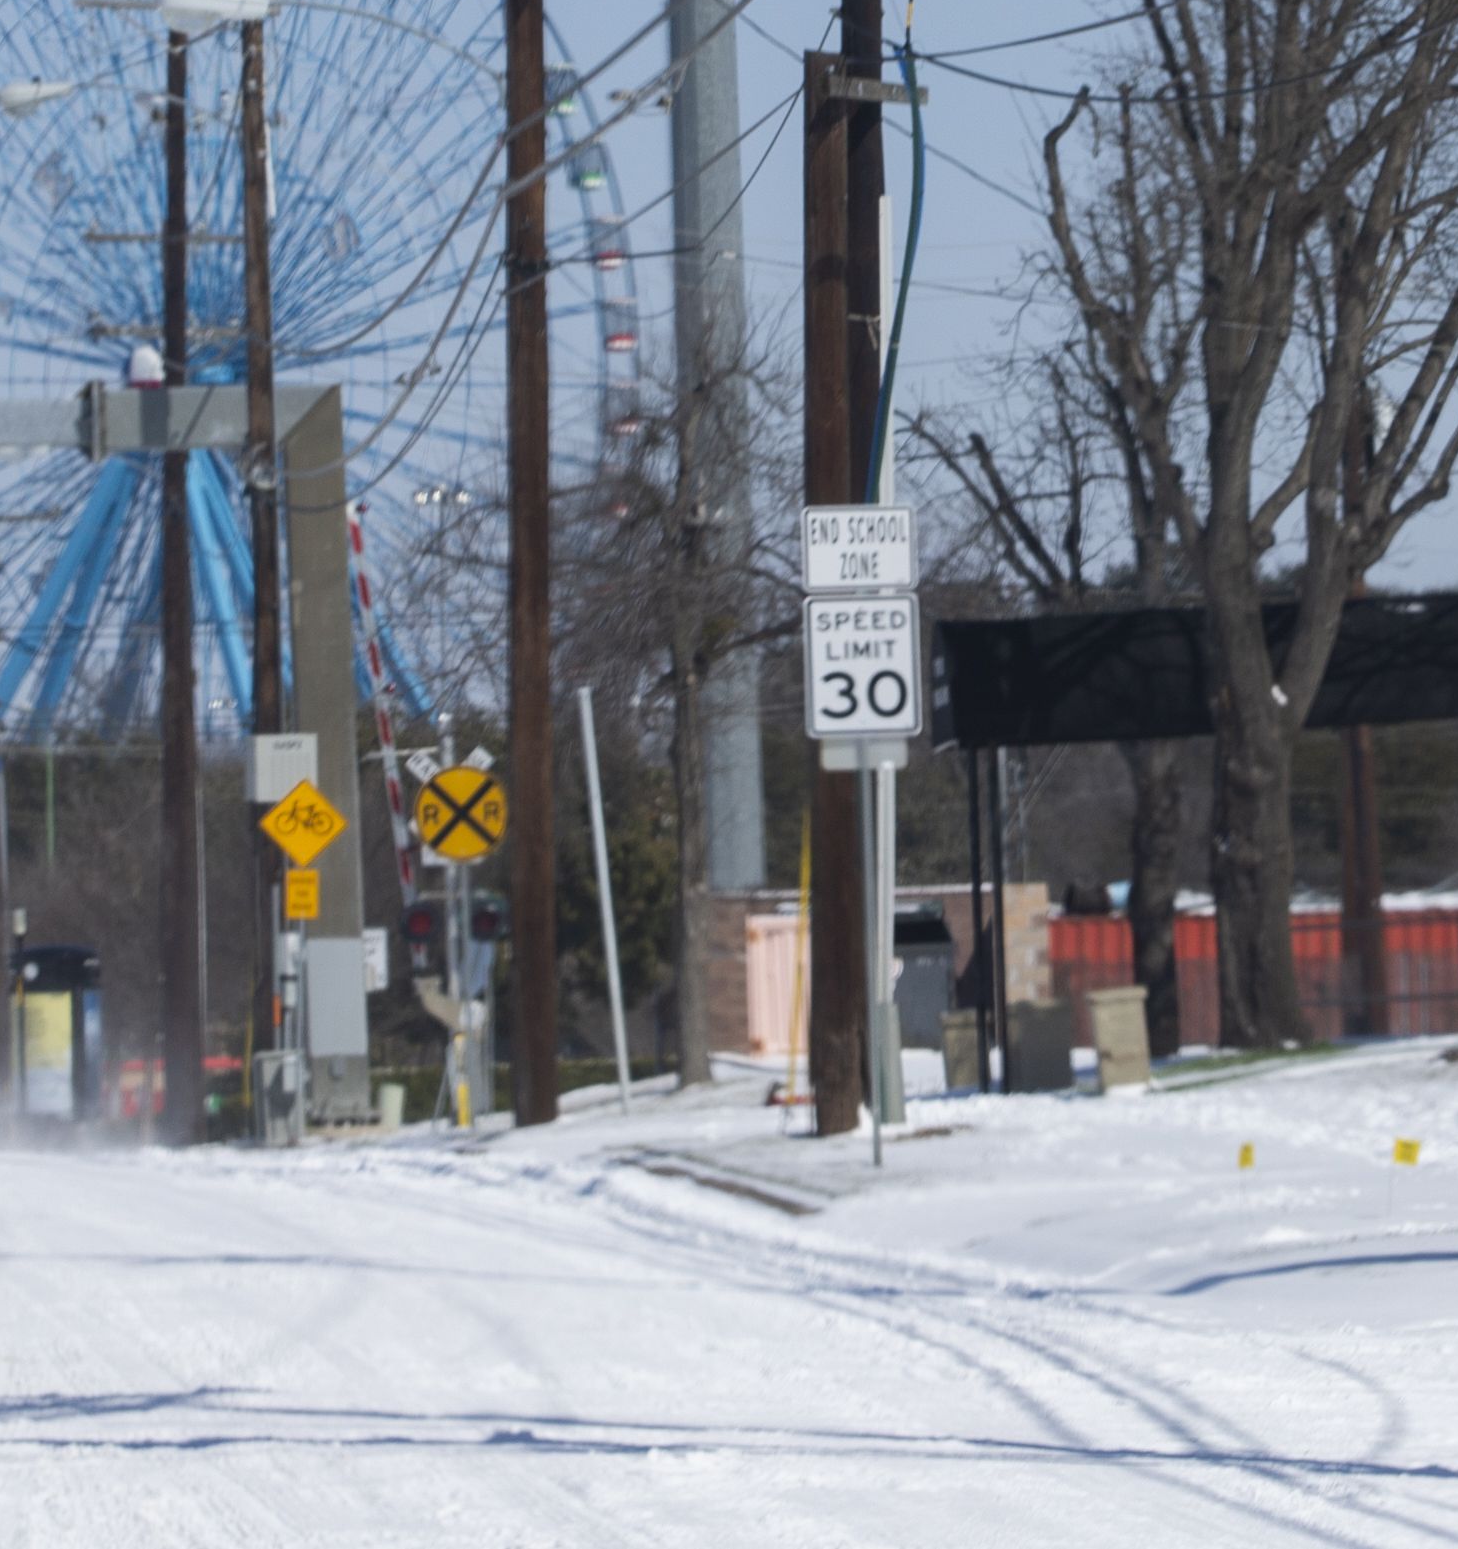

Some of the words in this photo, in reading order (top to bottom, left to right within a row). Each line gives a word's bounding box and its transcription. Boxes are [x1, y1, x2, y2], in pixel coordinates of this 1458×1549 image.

[811, 517, 839, 545] END
[848, 515, 907, 543] SCHOOL
[840, 552, 879, 579] ZONE
[816, 610, 907, 632] SPEED
[826, 640, 897, 661] LIMIT
[821, 670, 908, 719] 30
[423, 803, 439, 825] R
[484, 801, 499, 822] R
